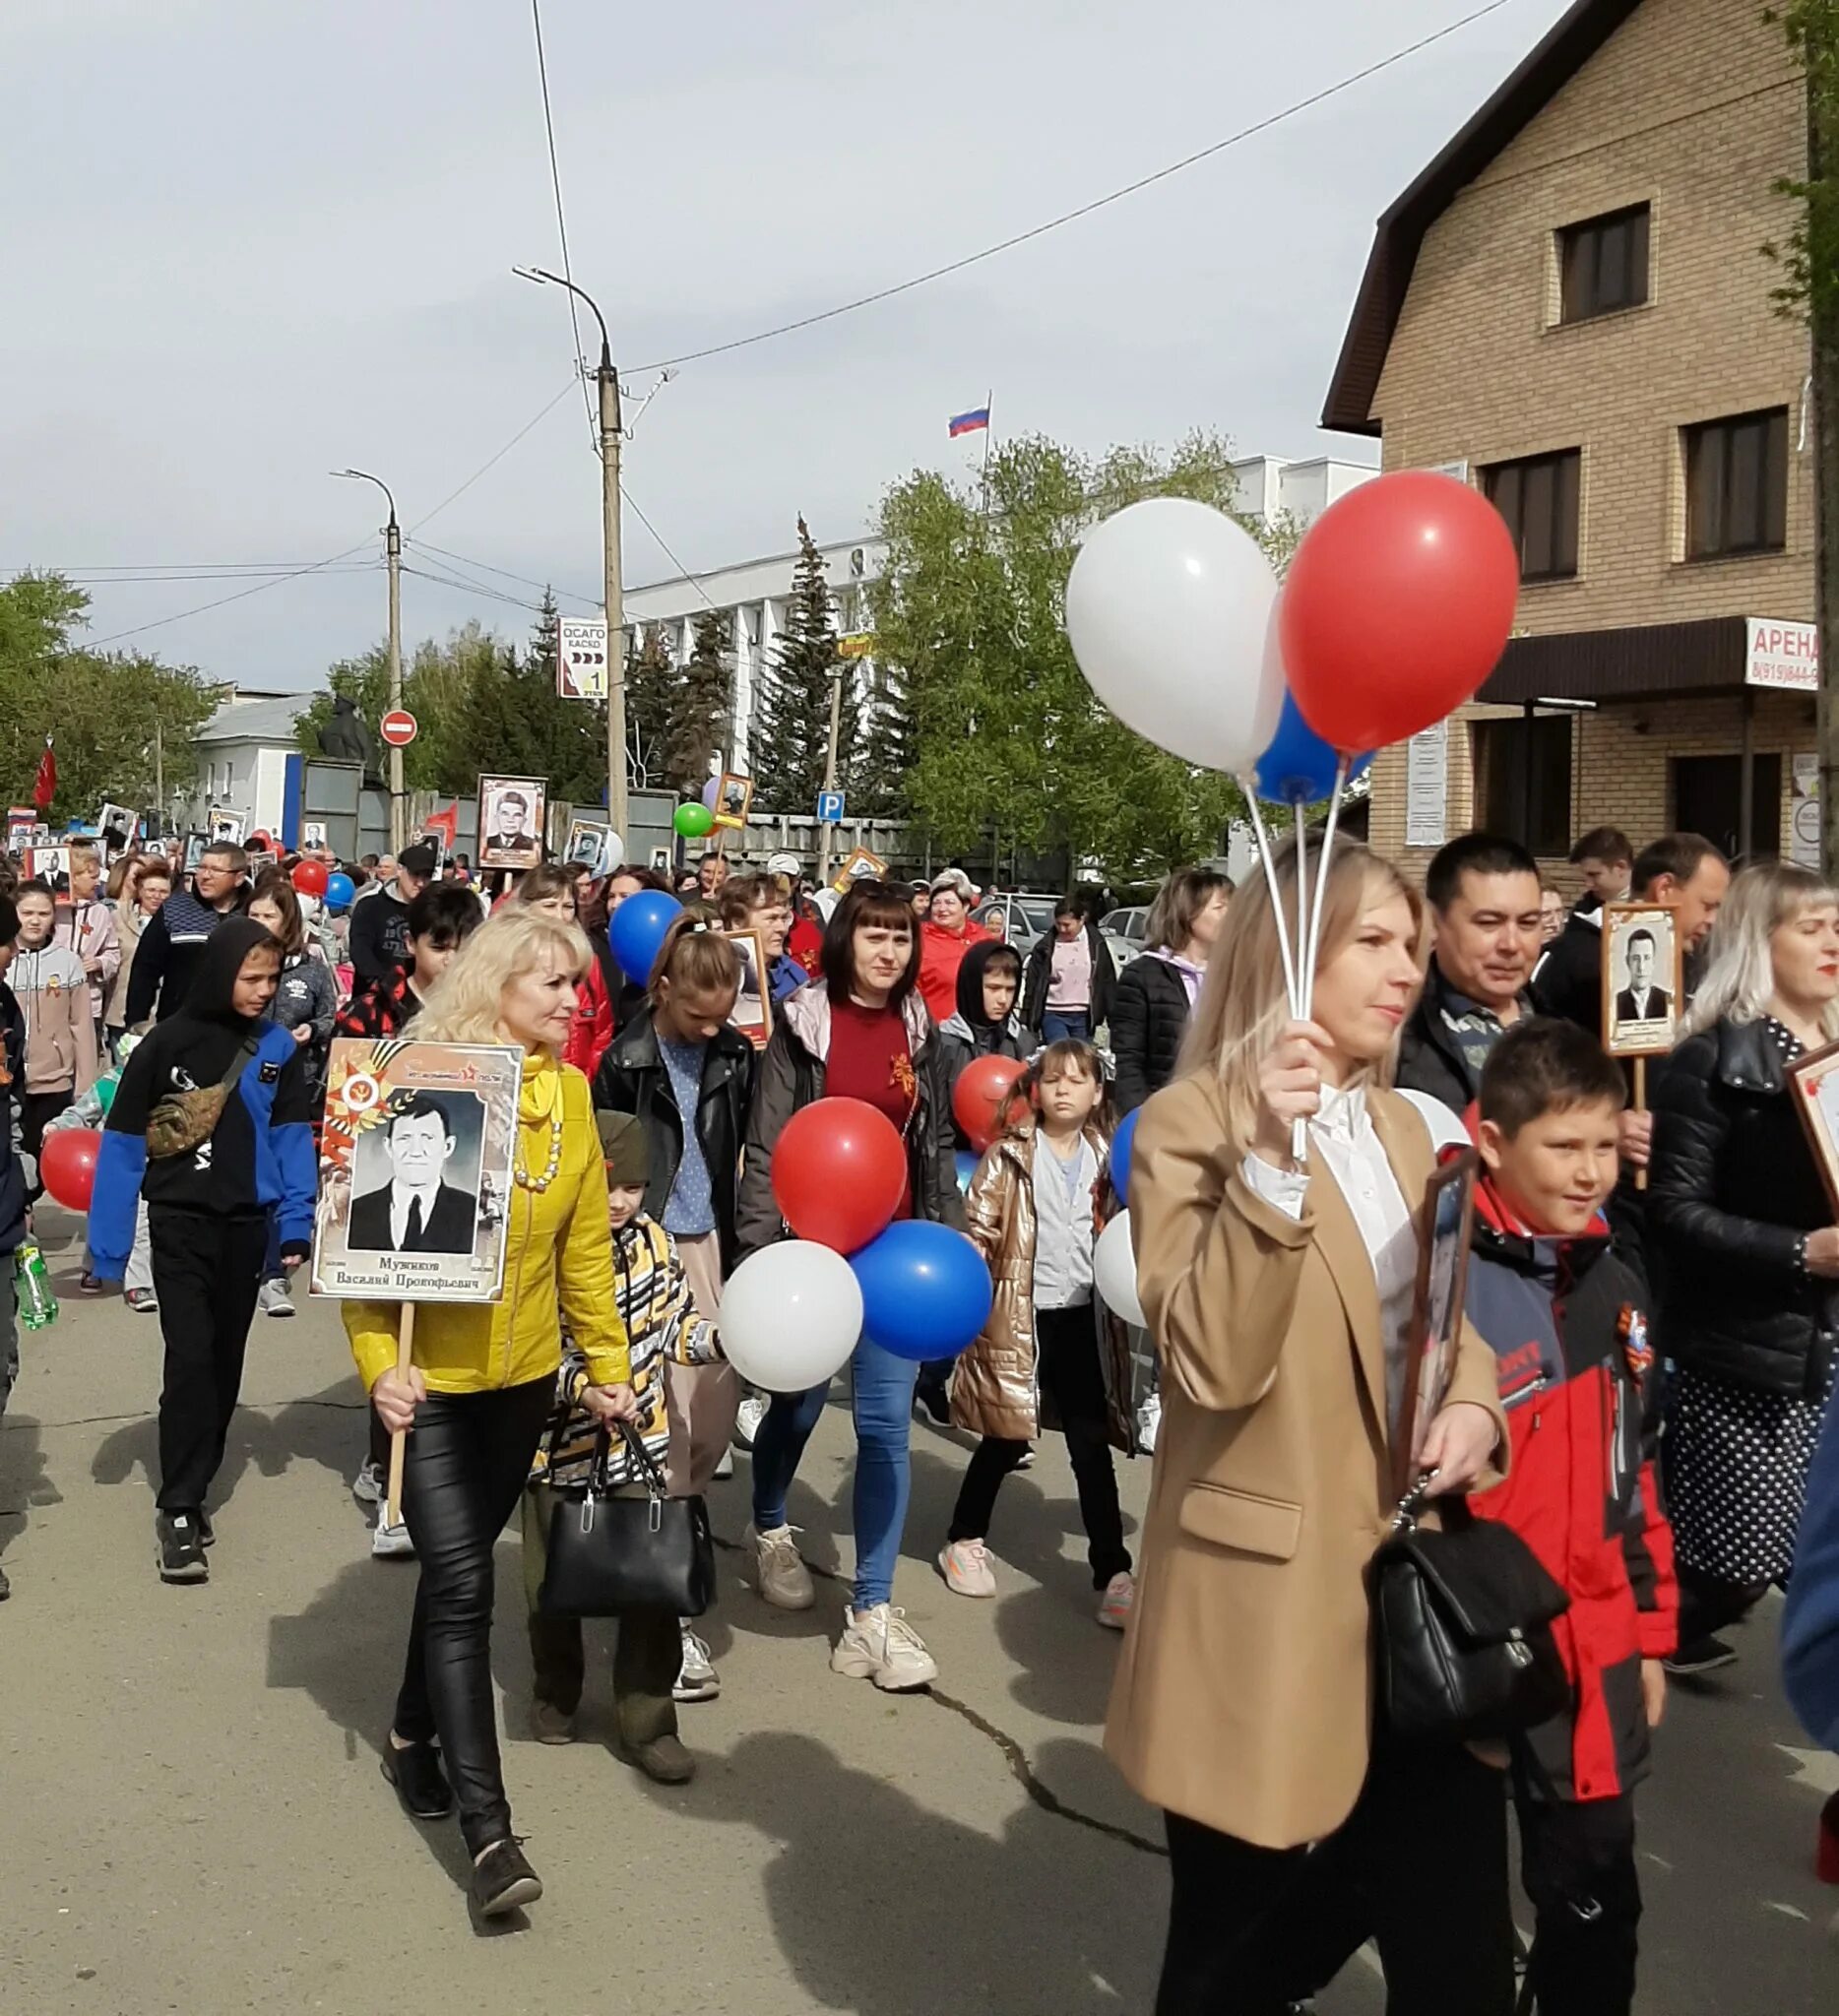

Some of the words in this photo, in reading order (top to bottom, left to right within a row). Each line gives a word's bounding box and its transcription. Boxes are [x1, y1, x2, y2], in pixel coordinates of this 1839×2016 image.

[563, 628, 605, 639] ОСАГО
[568, 640, 601, 649] КАСКО
[591, 671, 600, 690] 1
[825, 795, 840, 817] P
[379, 1257, 440, 1272] Мужиков
[337, 1271, 390, 1287] Василий
[396, 1274, 479, 1291] Прокофьевич
